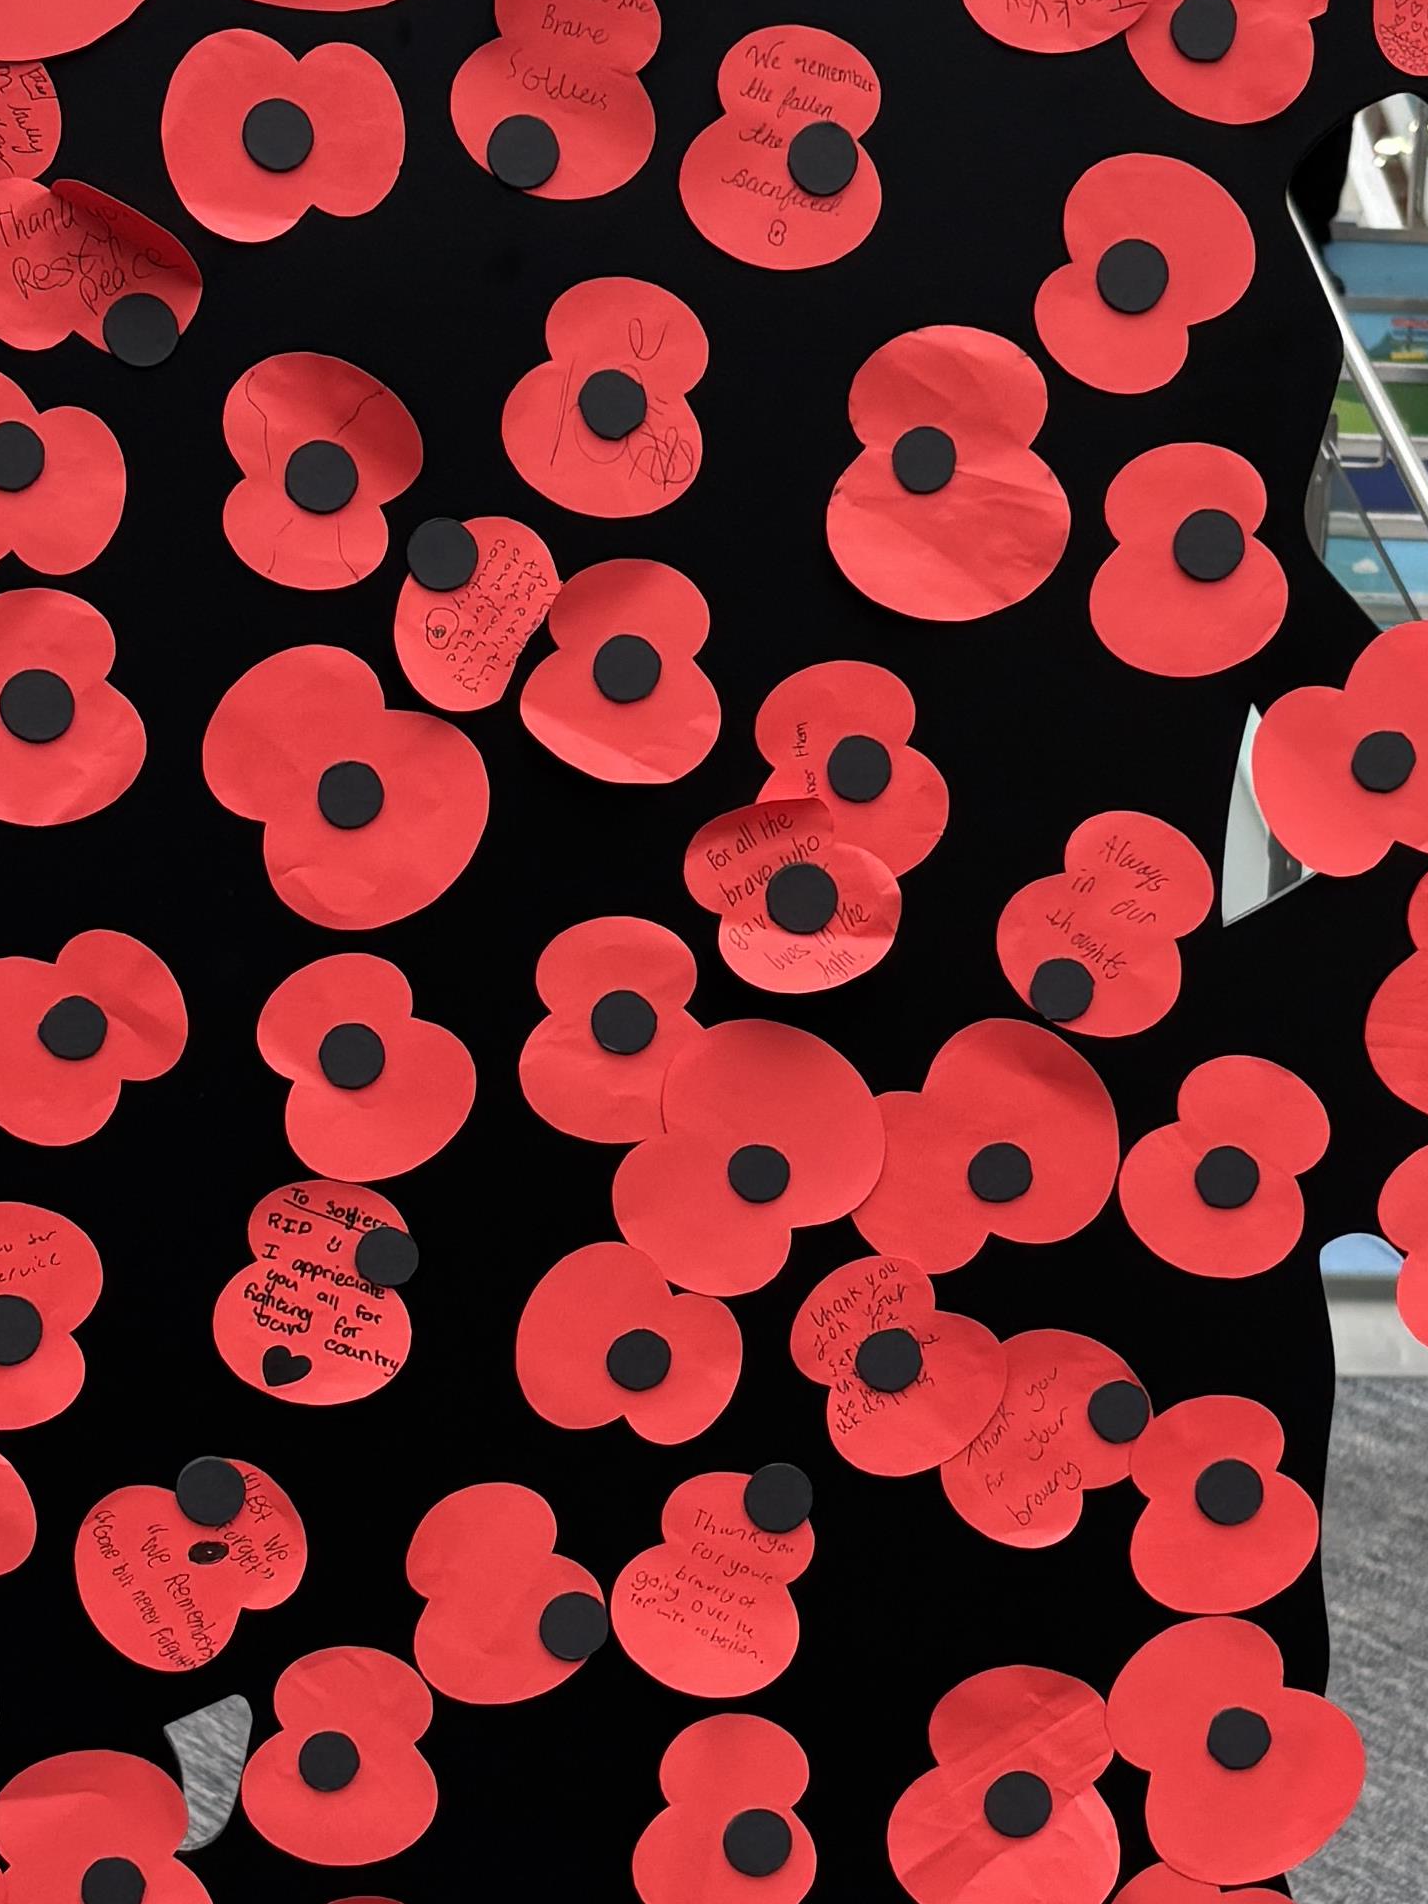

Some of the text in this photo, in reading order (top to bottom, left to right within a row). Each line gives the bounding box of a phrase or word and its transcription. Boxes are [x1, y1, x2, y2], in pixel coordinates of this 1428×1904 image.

[745, 41, 785, 70] We
[736, 823, 758, 855] all
[291, 1187, 311, 1206] To
[316, 1291, 340, 1312] all
[355, 1304, 383, 1326] for
[334, 1315, 364, 1339] for
[324, 1338, 401, 1378] country
